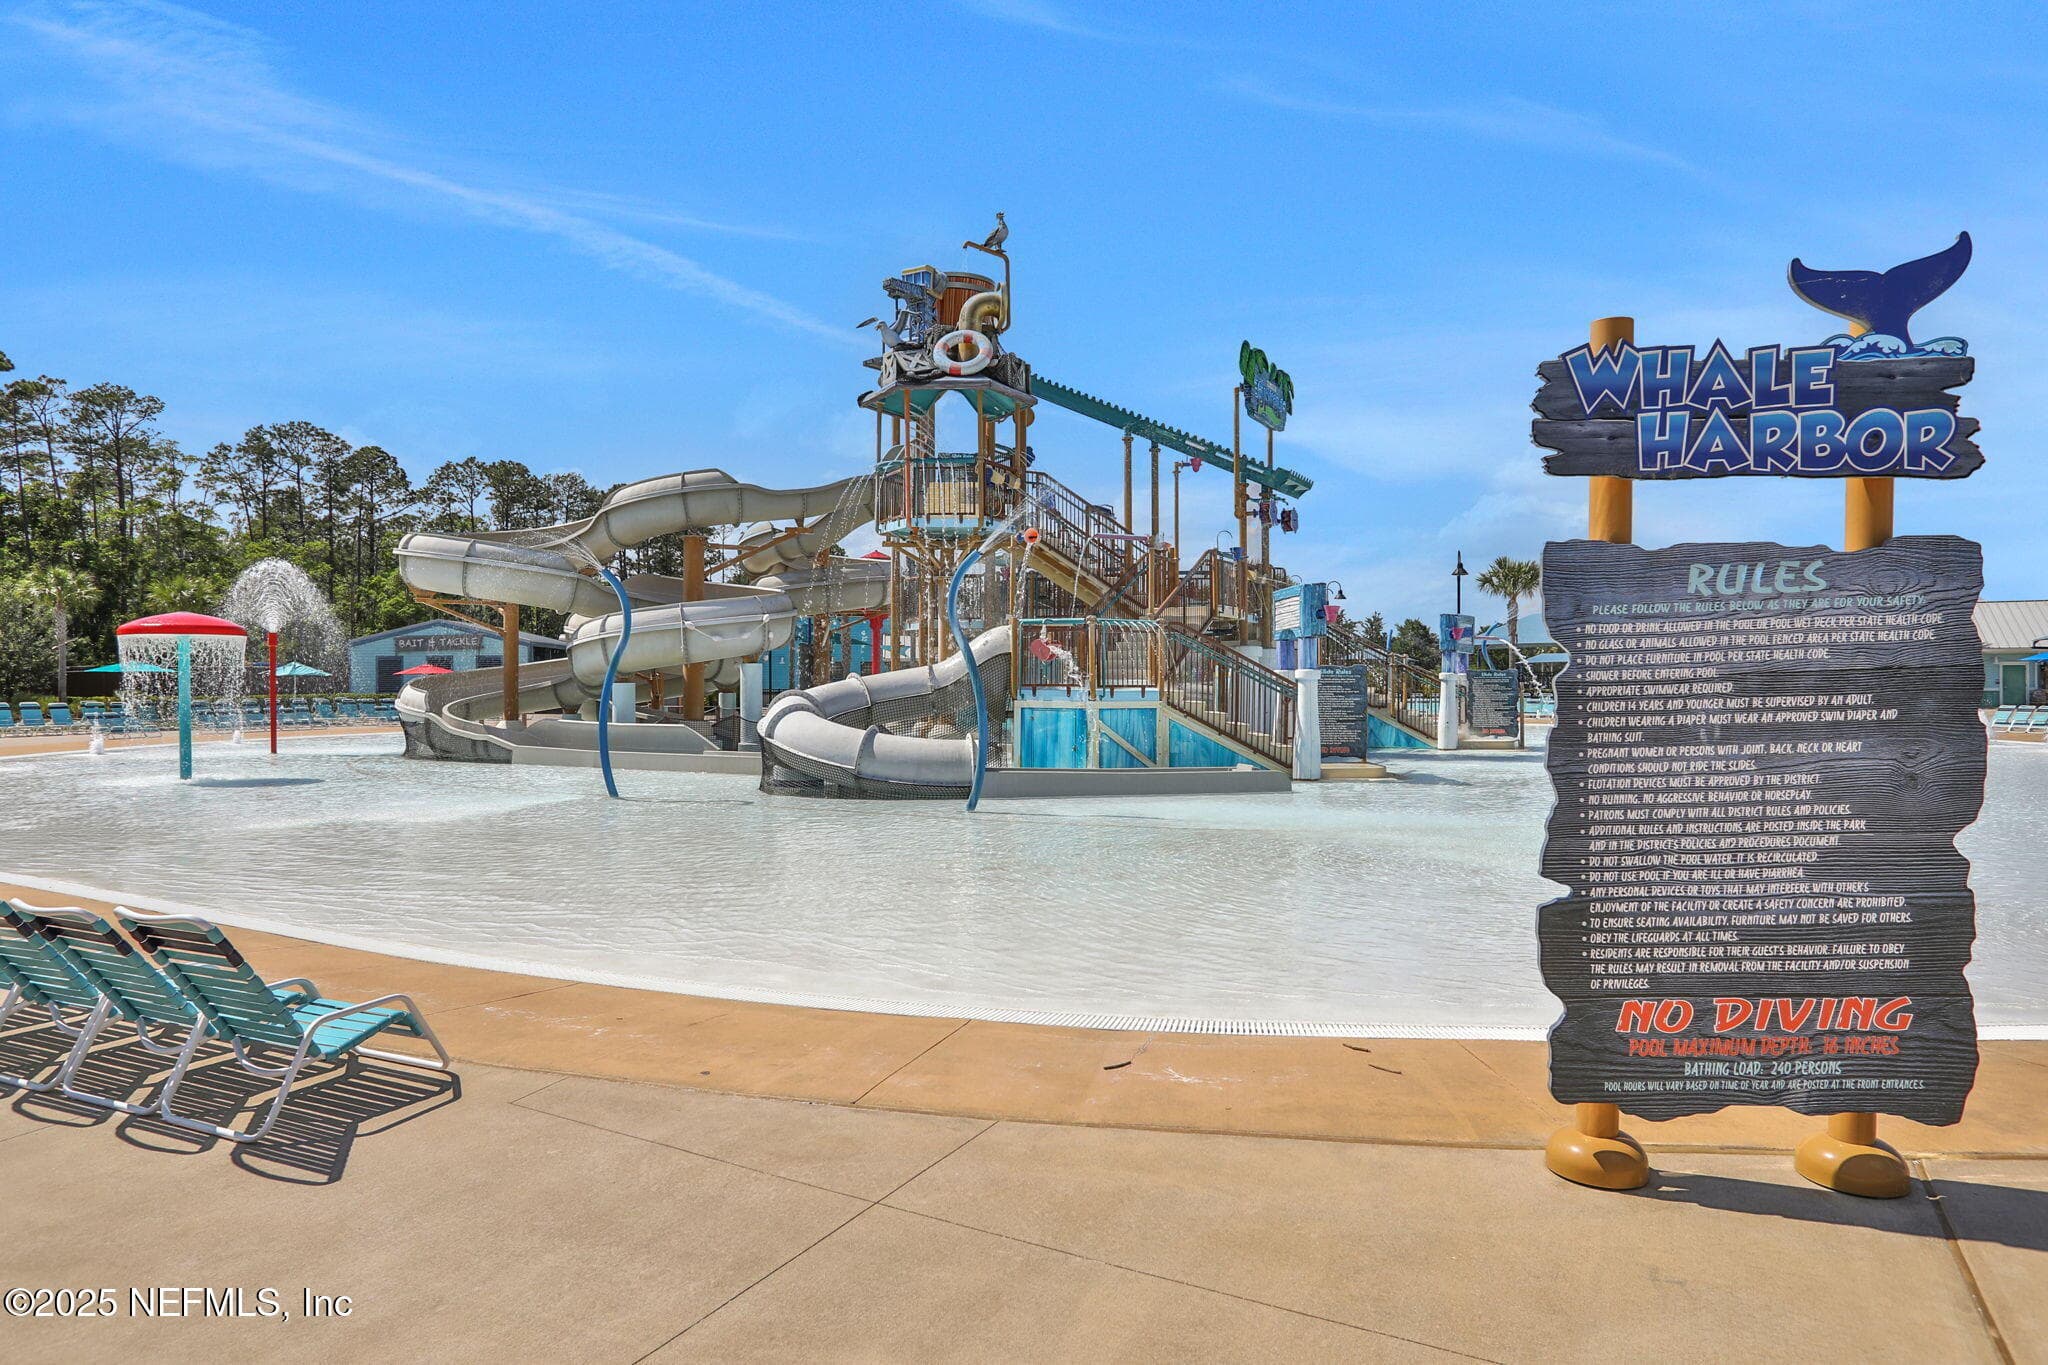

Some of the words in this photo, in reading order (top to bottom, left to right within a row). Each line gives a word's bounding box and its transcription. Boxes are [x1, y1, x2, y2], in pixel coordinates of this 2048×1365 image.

[1564, 340, 1836, 414] WHALE
[1636, 406, 1957, 473] HARBOR
[1687, 560, 1829, 597] RULES
[1593, 604, 1627, 616] PLEASE
[1630, 603, 1670, 615] FOLLOW
[1673, 602, 1692, 613] THE
[1694, 601, 1724, 613] RULES
[1727, 600, 1763, 612] BELOW
[1766, 600, 1779, 610] AS
[1782, 599, 1806, 610] THEY
[1810, 598, 1830, 609] ARE
[1833, 597, 1853, 608] FOR
[1856, 596, 1882, 608] YOUR
[399, 639, 424, 649] BAIT
[439, 637, 479, 647] TACKLE
[1586, 670, 1619, 681] SHOWER
[1622, 669, 1652, 680] BEFORE
[1654, 668, 1694, 680] ENTERING
[1586, 685, 1640, 697] APPROPRIATE
[1642, 684, 1689, 695] SWIMWEAR
[1587, 700, 1625, 712] CHILDREN
[1628, 700, 1636, 711] 14
[1638, 699, 1664, 710] YEARS
[1666, 699, 1683, 710] AND
[1686, 698, 1724, 709] YOUNGER
[1726, 697, 1749, 708] MUST
[1752, 697, 1762, 708] BE
[1765, 696, 1815, 707] SUPERVISED
[1818, 695, 1828, 706] BY
[1831, 695, 1842, 706] AN
[1845, 694, 1873, 705] ADULT.
[1588, 716, 1625, 727] CHILDREN
[1628, 715, 1665, 726] WEARING
[1667, 715, 1673, 725] A
[1676, 714, 1706, 725] DIAPER
[1708, 713, 1731, 724] MUST
[1734, 713, 1758, 724] WEAR
[1760, 712, 1772, 723] AN
[1775, 711, 1818, 723] APPROVED
[1820, 711, 1844, 722] SWIM
[1846, 710, 1876, 721] DIAPER
[1879, 709, 1897, 720] AND
[1588, 732, 1621, 743] BATHING
[1624, 732, 1645, 742] SUIT.
[1588, 762, 1635, 774] CONDITIONS
[1637, 762, 1669, 773] SHOULD
[1671, 761, 1687, 772] NOT
[1689, 761, 1708, 772] RIDE
[1710, 761, 1725, 771] THE
[1588, 809, 1624, 820] PATRONS
[1626, 808, 1649, 819] MUST
[1652, 807, 1685, 818] COMPLY
[1688, 807, 1708, 818] WITH
[1710, 807, 1725, 817] ALL
[1727, 806, 1762, 817] DISTRICT
[1765, 805, 1790, 816] RULES
[1793, 805, 1810, 816] AND
[1589, 824, 1636, 835] ADDITIONAL
[1638, 823, 1663, 834] RULES
[1666, 823, 1683, 833] AND
[1685, 822, 1742, 833] INSTRUCTIONS
[1745, 821, 1761, 832] ARE
[1763, 821, 1794, 832] POSTED
[1796, 820, 1823, 831] INSIDE
[1825, 820, 1841, 830] THE
[1843, 819, 1865, 830] PARK
[1590, 886, 1606, 897] ANY
[1608, 886, 1649, 897] PERSONAL
[1651, 885, 1684, 896] DEVICES
[1686, 885, 1698, 895] OR
[1700, 884, 1720, 895] TOYS
[1722, 884, 1743, 895] THAT
[1746, 884, 1764, 894] MAY
[1767, 883, 1810, 894] INTERFERE
[1812, 882, 1833, 893] WITH
[1590, 901, 1638, 912] ENJOYMENT
[1640, 901, 1651, 912] OF
[1654, 901, 1669, 911] THE
[1671, 900, 1706, 911] FACILITY
[1708, 900, 1719, 910] OR
[1722, 900, 1752, 910] CREATE
[1755, 899, 1761, 910] A
[1764, 899, 1793, 910] SAFETY
[1796, 898, 1834, 909] CONCERN
[1836, 898, 1853, 909] ARE
[1855, 897, 1906, 908] PROHIBITED.
[1590, 917, 1600, 928] TO
[1602, 917, 1633, 928] ENSURE
[1636, 916, 1669, 927] SEATING
[1730, 915, 1776, 926] FURNITURE
[1778, 914, 1797, 925] MAY
[1800, 914, 1816, 925] NOT
[1818, 914, 1829, 924] BE
[1832, 913, 1858, 924] SAVED
[1861, 913, 1876, 924] FOR
[1590, 933, 1611, 943] OBEY
[1613, 932, 1628, 943] THE
[1631, 932, 1679, 943] LIFEGUARDS
[1682, 931, 1692, 942] AT
[1694, 931, 1710, 942] ALL
[1590, 948, 1632, 958] RESIDENTS
[1634, 947, 1650, 958] ARE
[1653, 946, 1706, 958] RESPONSIBLE
[1708, 946, 1724, 957] FOR
[1726, 946, 1749, 957] THEIR
[1832, 944, 1866, 955] FAILURE
[1868, 944, 1879, 955] TO
[1882, 944, 1904, 954] OBEY
[1591, 963, 1605, 974] THE
[1608, 963, 1633, 973] RULES
[1635, 962, 1654, 973] MAY
[1656, 962, 1685, 973] RESULT
[1688, 962, 1697, 972] IN
[1699, 961, 1739, 972] REMOVAL
[1741, 961, 1764, 971] FROM
[1767, 960, 1782, 971] THE
[1785, 960, 1820, 971] FACILITY
[1823, 959, 1855, 970] AND/OR
[1858, 959, 1909, 970] SUSPENSION
[1591, 979, 1600, 989] OF
[1615, 998, 1695, 1034] NO
[1713, 995, 1915, 1034] DIVING
[1630, 1039, 1667, 1056] POOL
[1685, 1062, 1730, 1074] BATHING
[1733, 1062, 1763, 1074] LOAD:
[1771, 1062, 1790, 1074] 240
[1794, 1062, 1841, 1074] PERSONS
